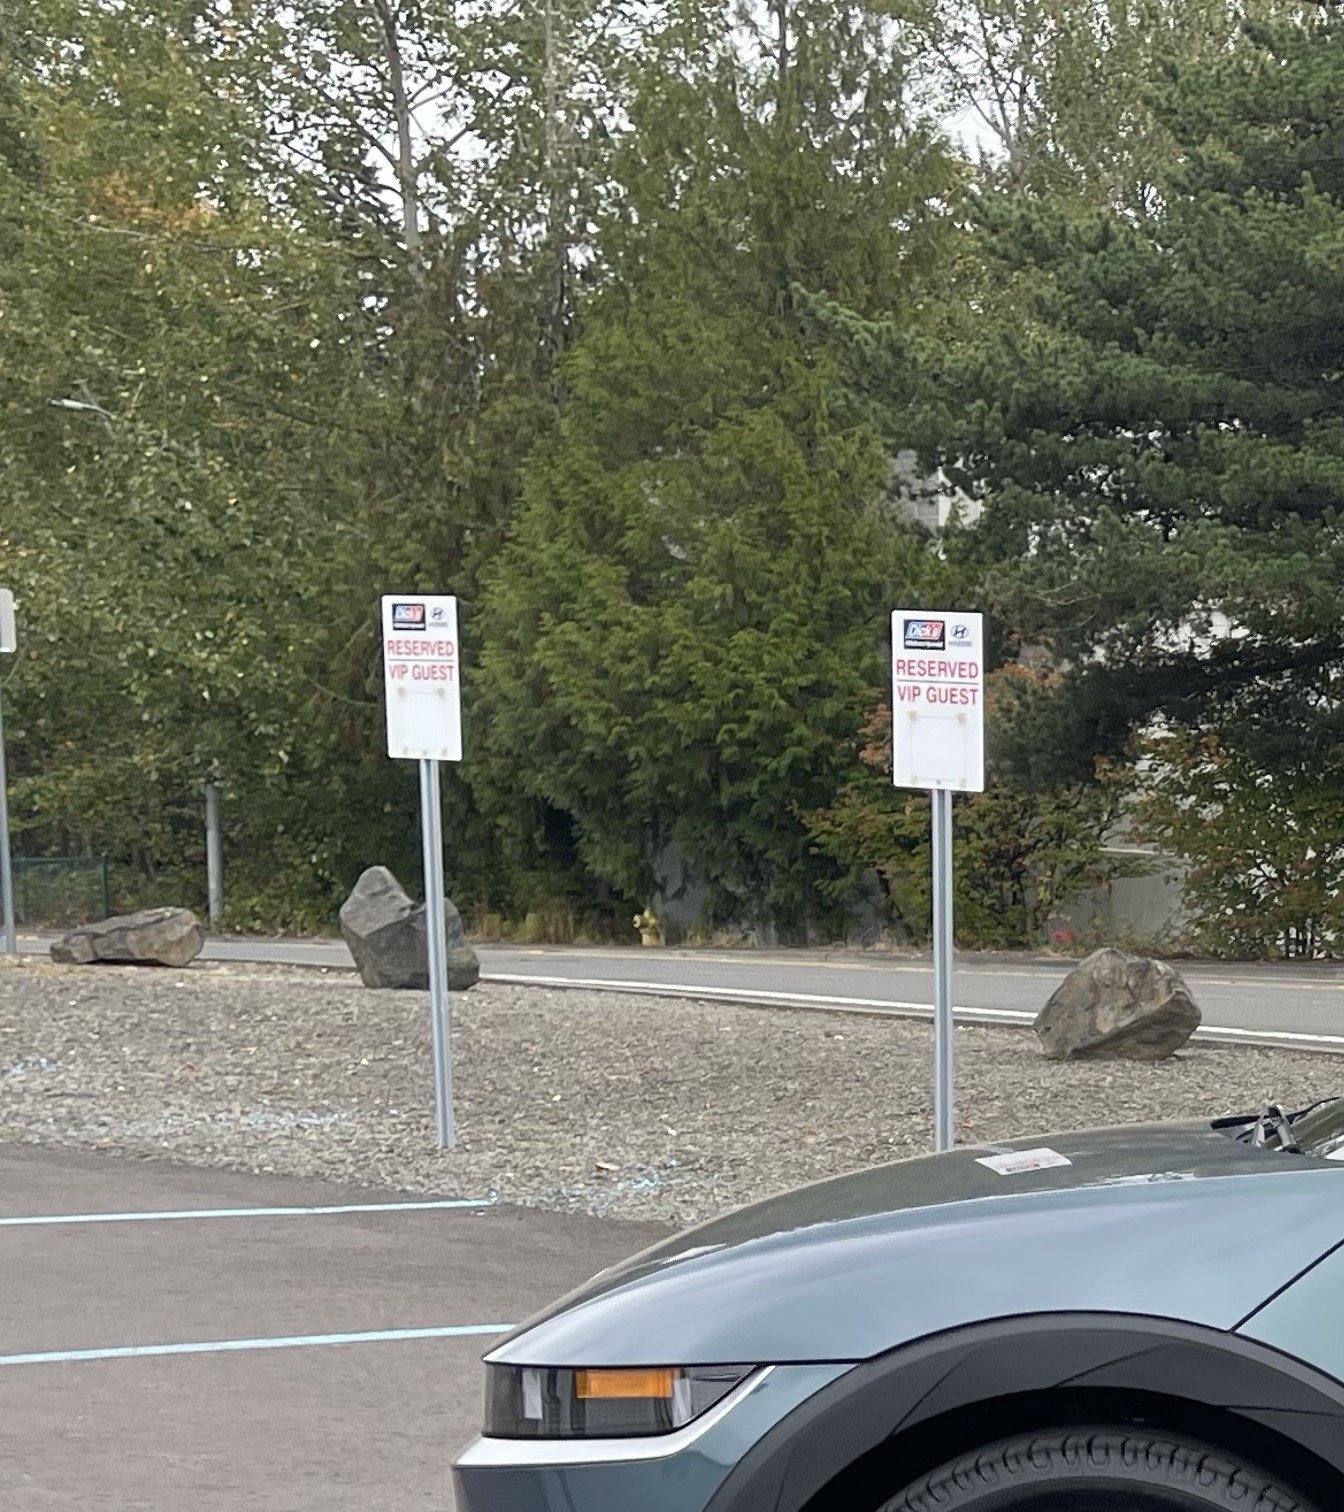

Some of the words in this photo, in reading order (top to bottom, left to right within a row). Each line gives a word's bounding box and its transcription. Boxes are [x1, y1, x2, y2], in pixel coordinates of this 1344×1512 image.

[388, 639, 454, 657] RESERVED
[389, 665, 408, 680] VIP
[412, 665, 455, 681] GUEST
[896, 659, 979, 679] RESERVED
[897, 685, 921, 702] VIP
[926, 686, 979, 705] GUEST
